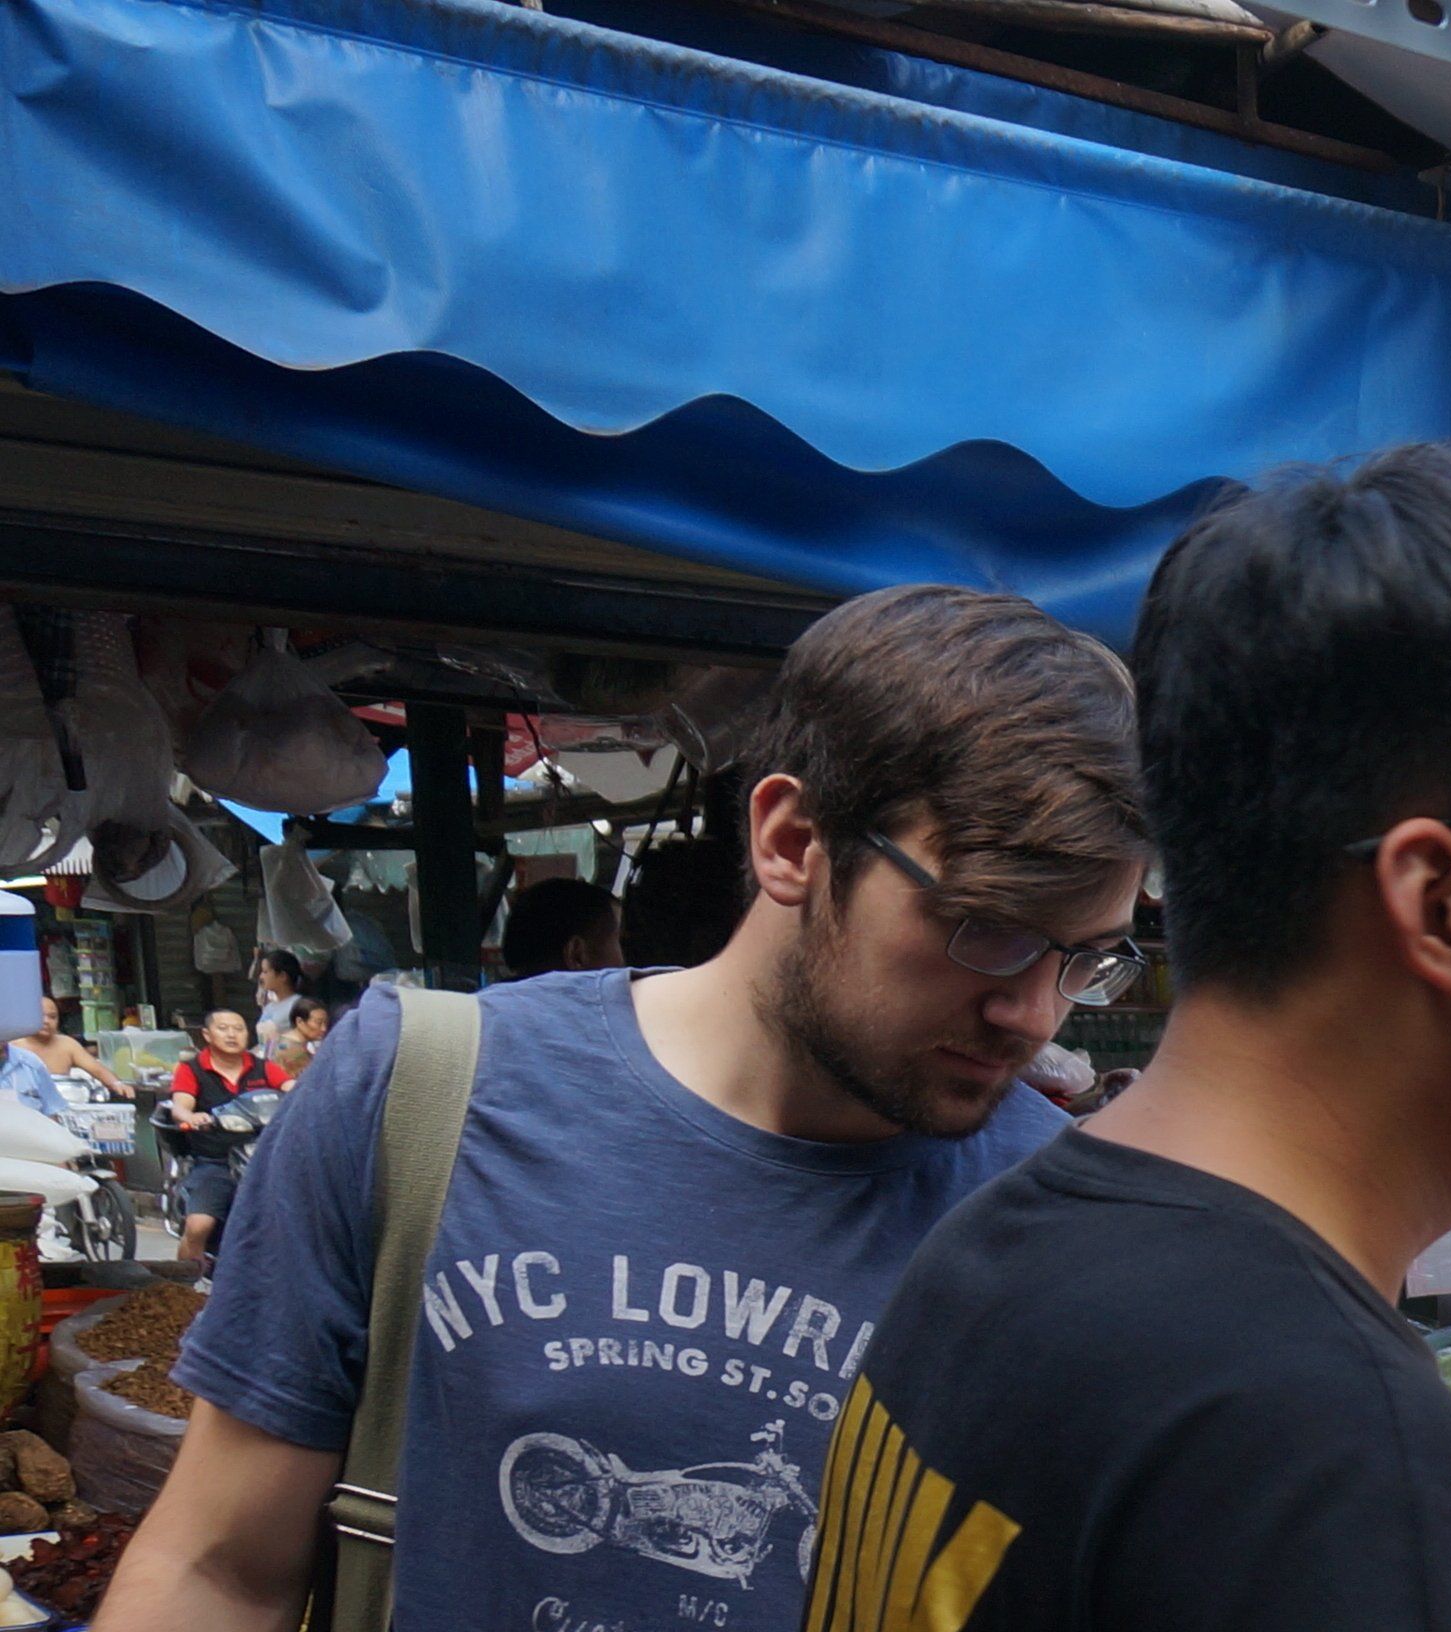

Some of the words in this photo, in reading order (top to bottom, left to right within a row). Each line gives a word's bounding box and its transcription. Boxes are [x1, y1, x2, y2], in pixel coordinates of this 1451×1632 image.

[424, 1250, 568, 1353] NYC
[543, 1336, 710, 1378] SPRING
[677, 1593, 730, 1628] M/C
